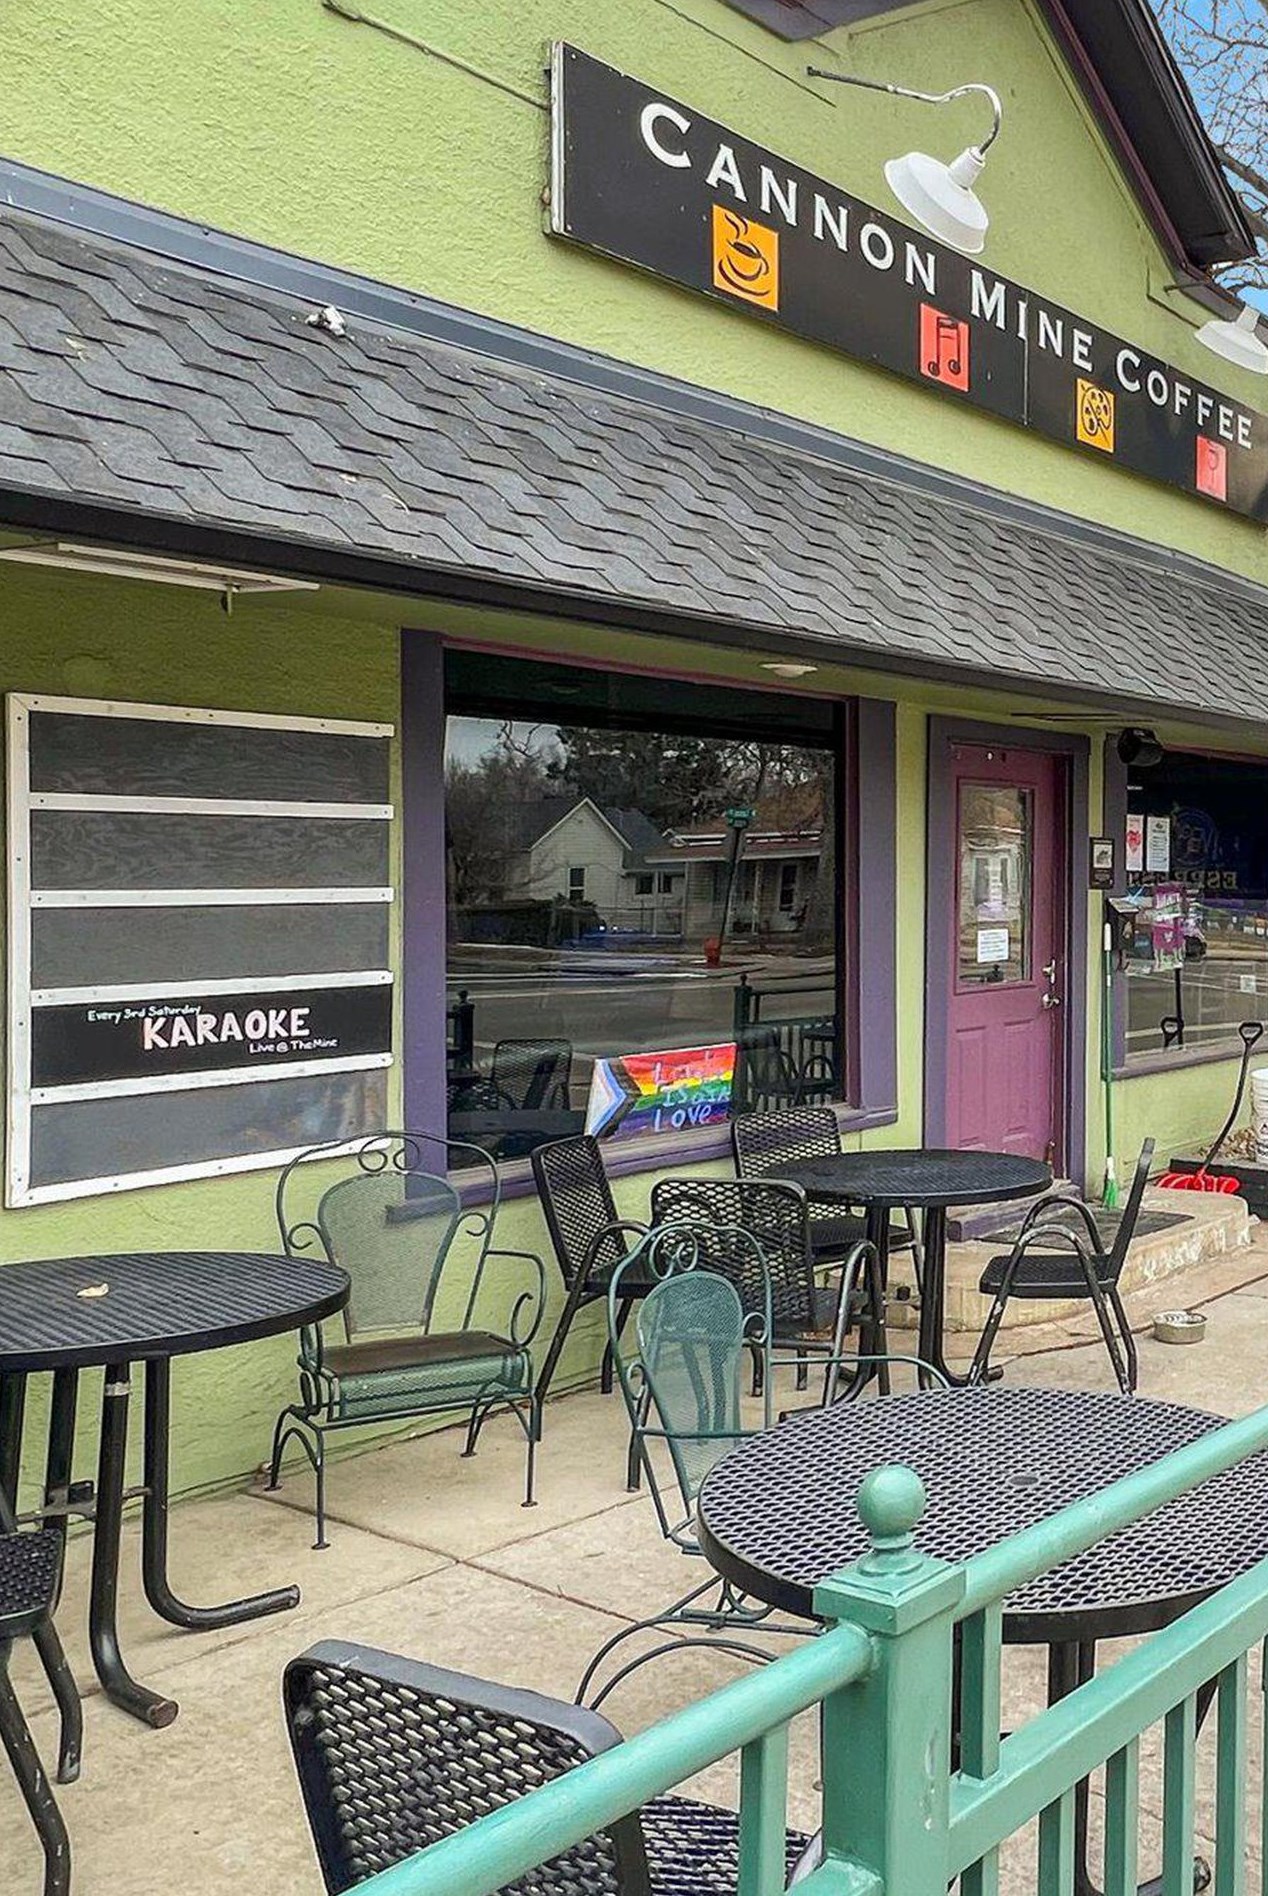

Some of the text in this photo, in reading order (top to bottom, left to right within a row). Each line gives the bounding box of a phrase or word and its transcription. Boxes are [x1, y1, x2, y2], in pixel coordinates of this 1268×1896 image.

[641, 102, 1253, 450] CANNON MINE COFFEE
[87, 1004, 202, 1025] Every 3rd Saturday
[143, 1007, 311, 1051] KARAOKE
[249, 1042, 275, 1054] Live
[276, 1041, 289, 1053] @
